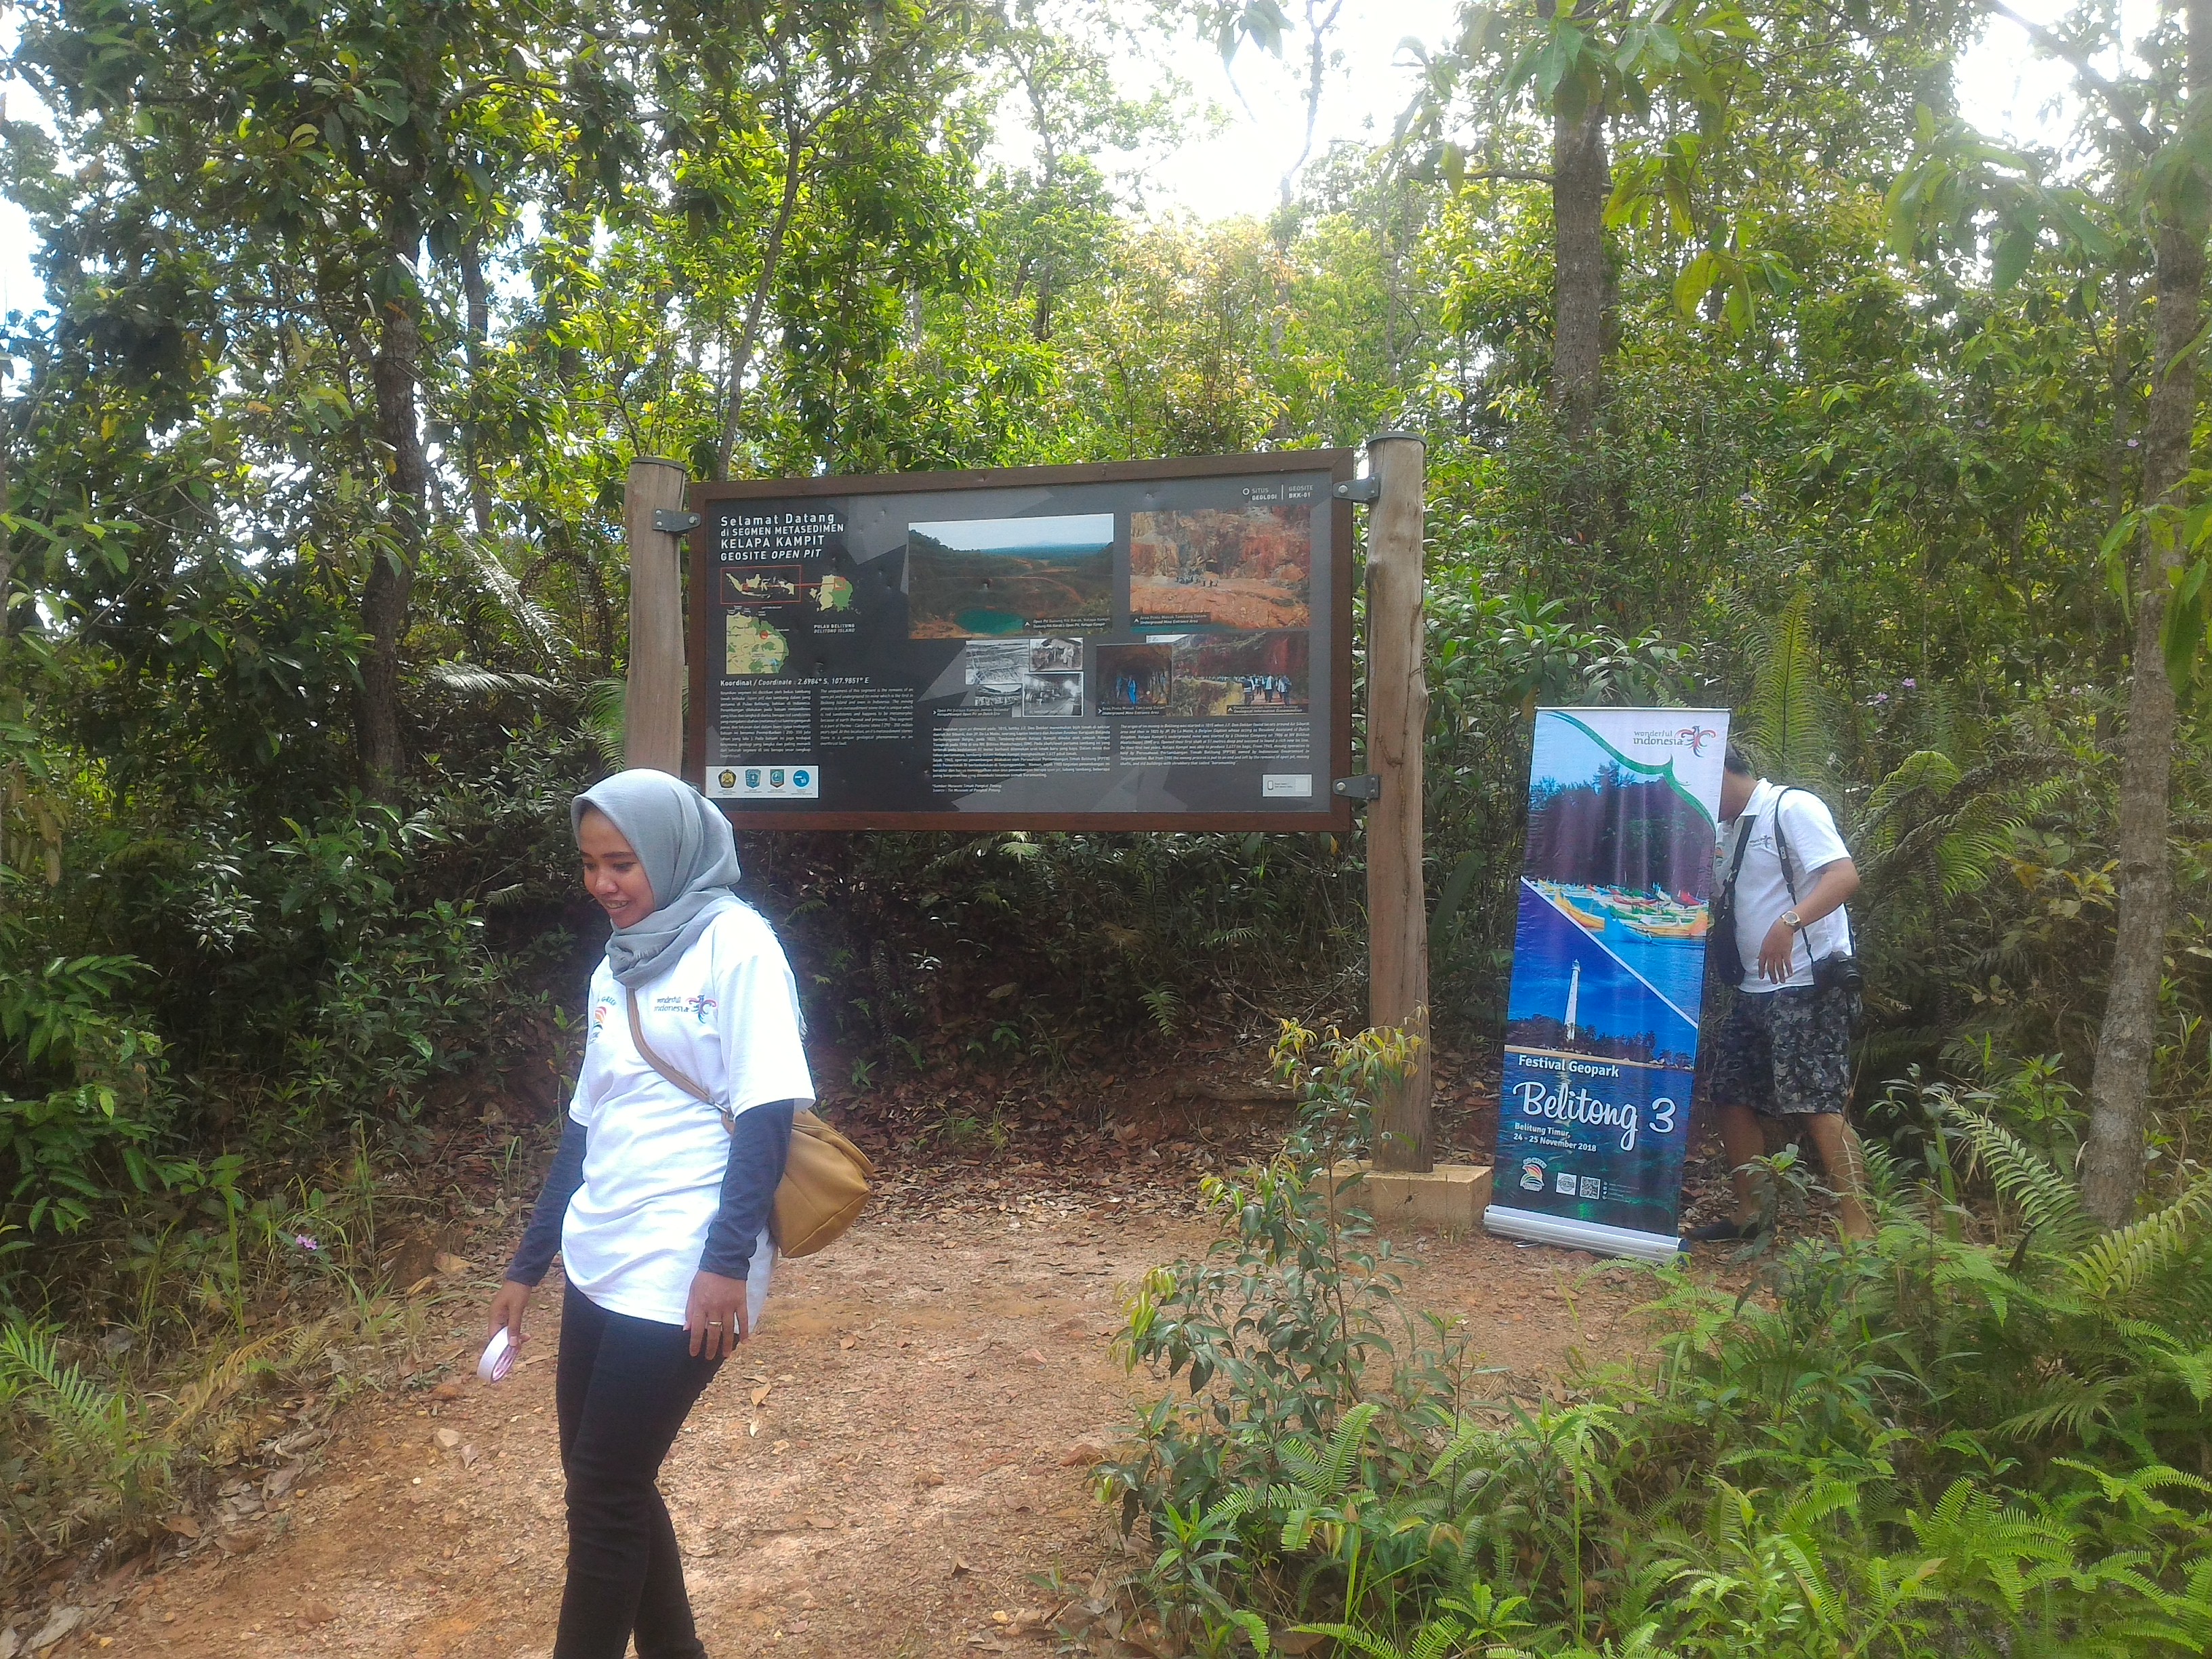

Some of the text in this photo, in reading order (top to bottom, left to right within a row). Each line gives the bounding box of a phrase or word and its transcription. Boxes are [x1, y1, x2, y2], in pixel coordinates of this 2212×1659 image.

[720, 513, 835, 527] Selamat Datang
[732, 527, 771, 537] SEGMEN
[775, 524, 844, 535] METASEDIMEN
[721, 535, 825, 549] KELAPA KAMPIT
[720, 549, 821, 561] GEOSITE OPEN PIT
[720, 679, 752, 687] Koordinat
[1633, 735, 1683, 745] indonesia
[1518, 1054, 1620, 1078] Festival Geopark
[1512, 1081, 1676, 1151] Belitong 3
[1514, 1122, 1571, 1139] Belitung Timur,
[1513, 1132, 1523, 1141] 24
[1529, 1134, 1539, 1143] 25
[1540, 1135, 1577, 1150] November
[1578, 1143, 1597, 1152] 2018
